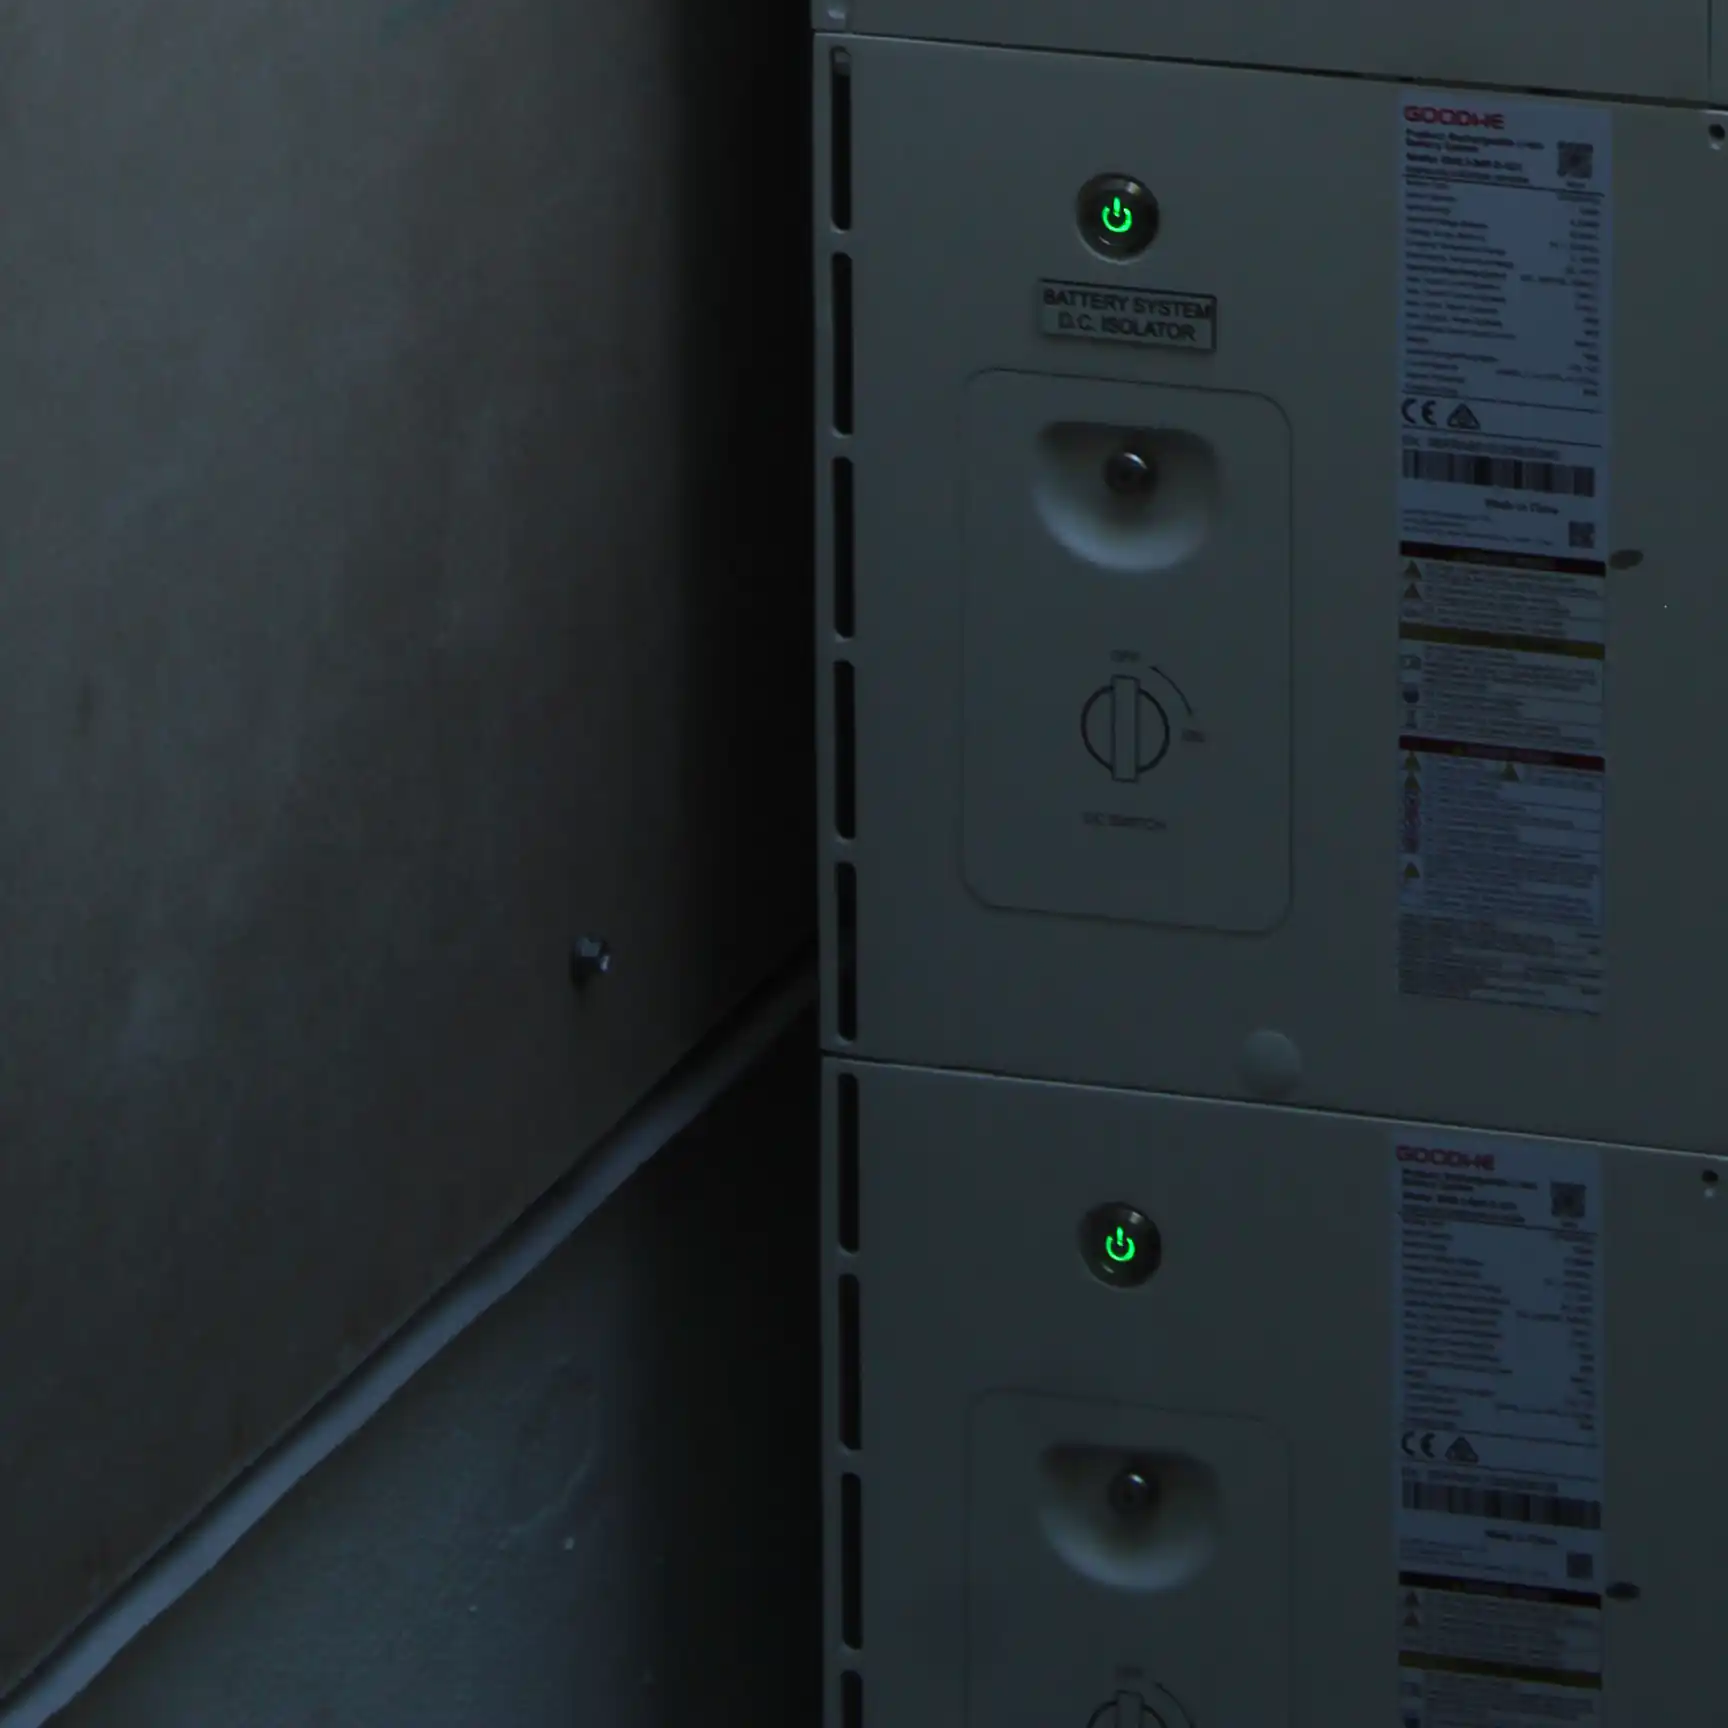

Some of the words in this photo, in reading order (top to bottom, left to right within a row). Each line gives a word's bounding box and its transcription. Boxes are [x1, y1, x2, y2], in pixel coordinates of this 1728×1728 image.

[1043, 287, 1129, 312] BATTERY
[1132, 296, 1211, 319] SYSTEM
[1101, 315, 1197, 342] ISOLATOR
